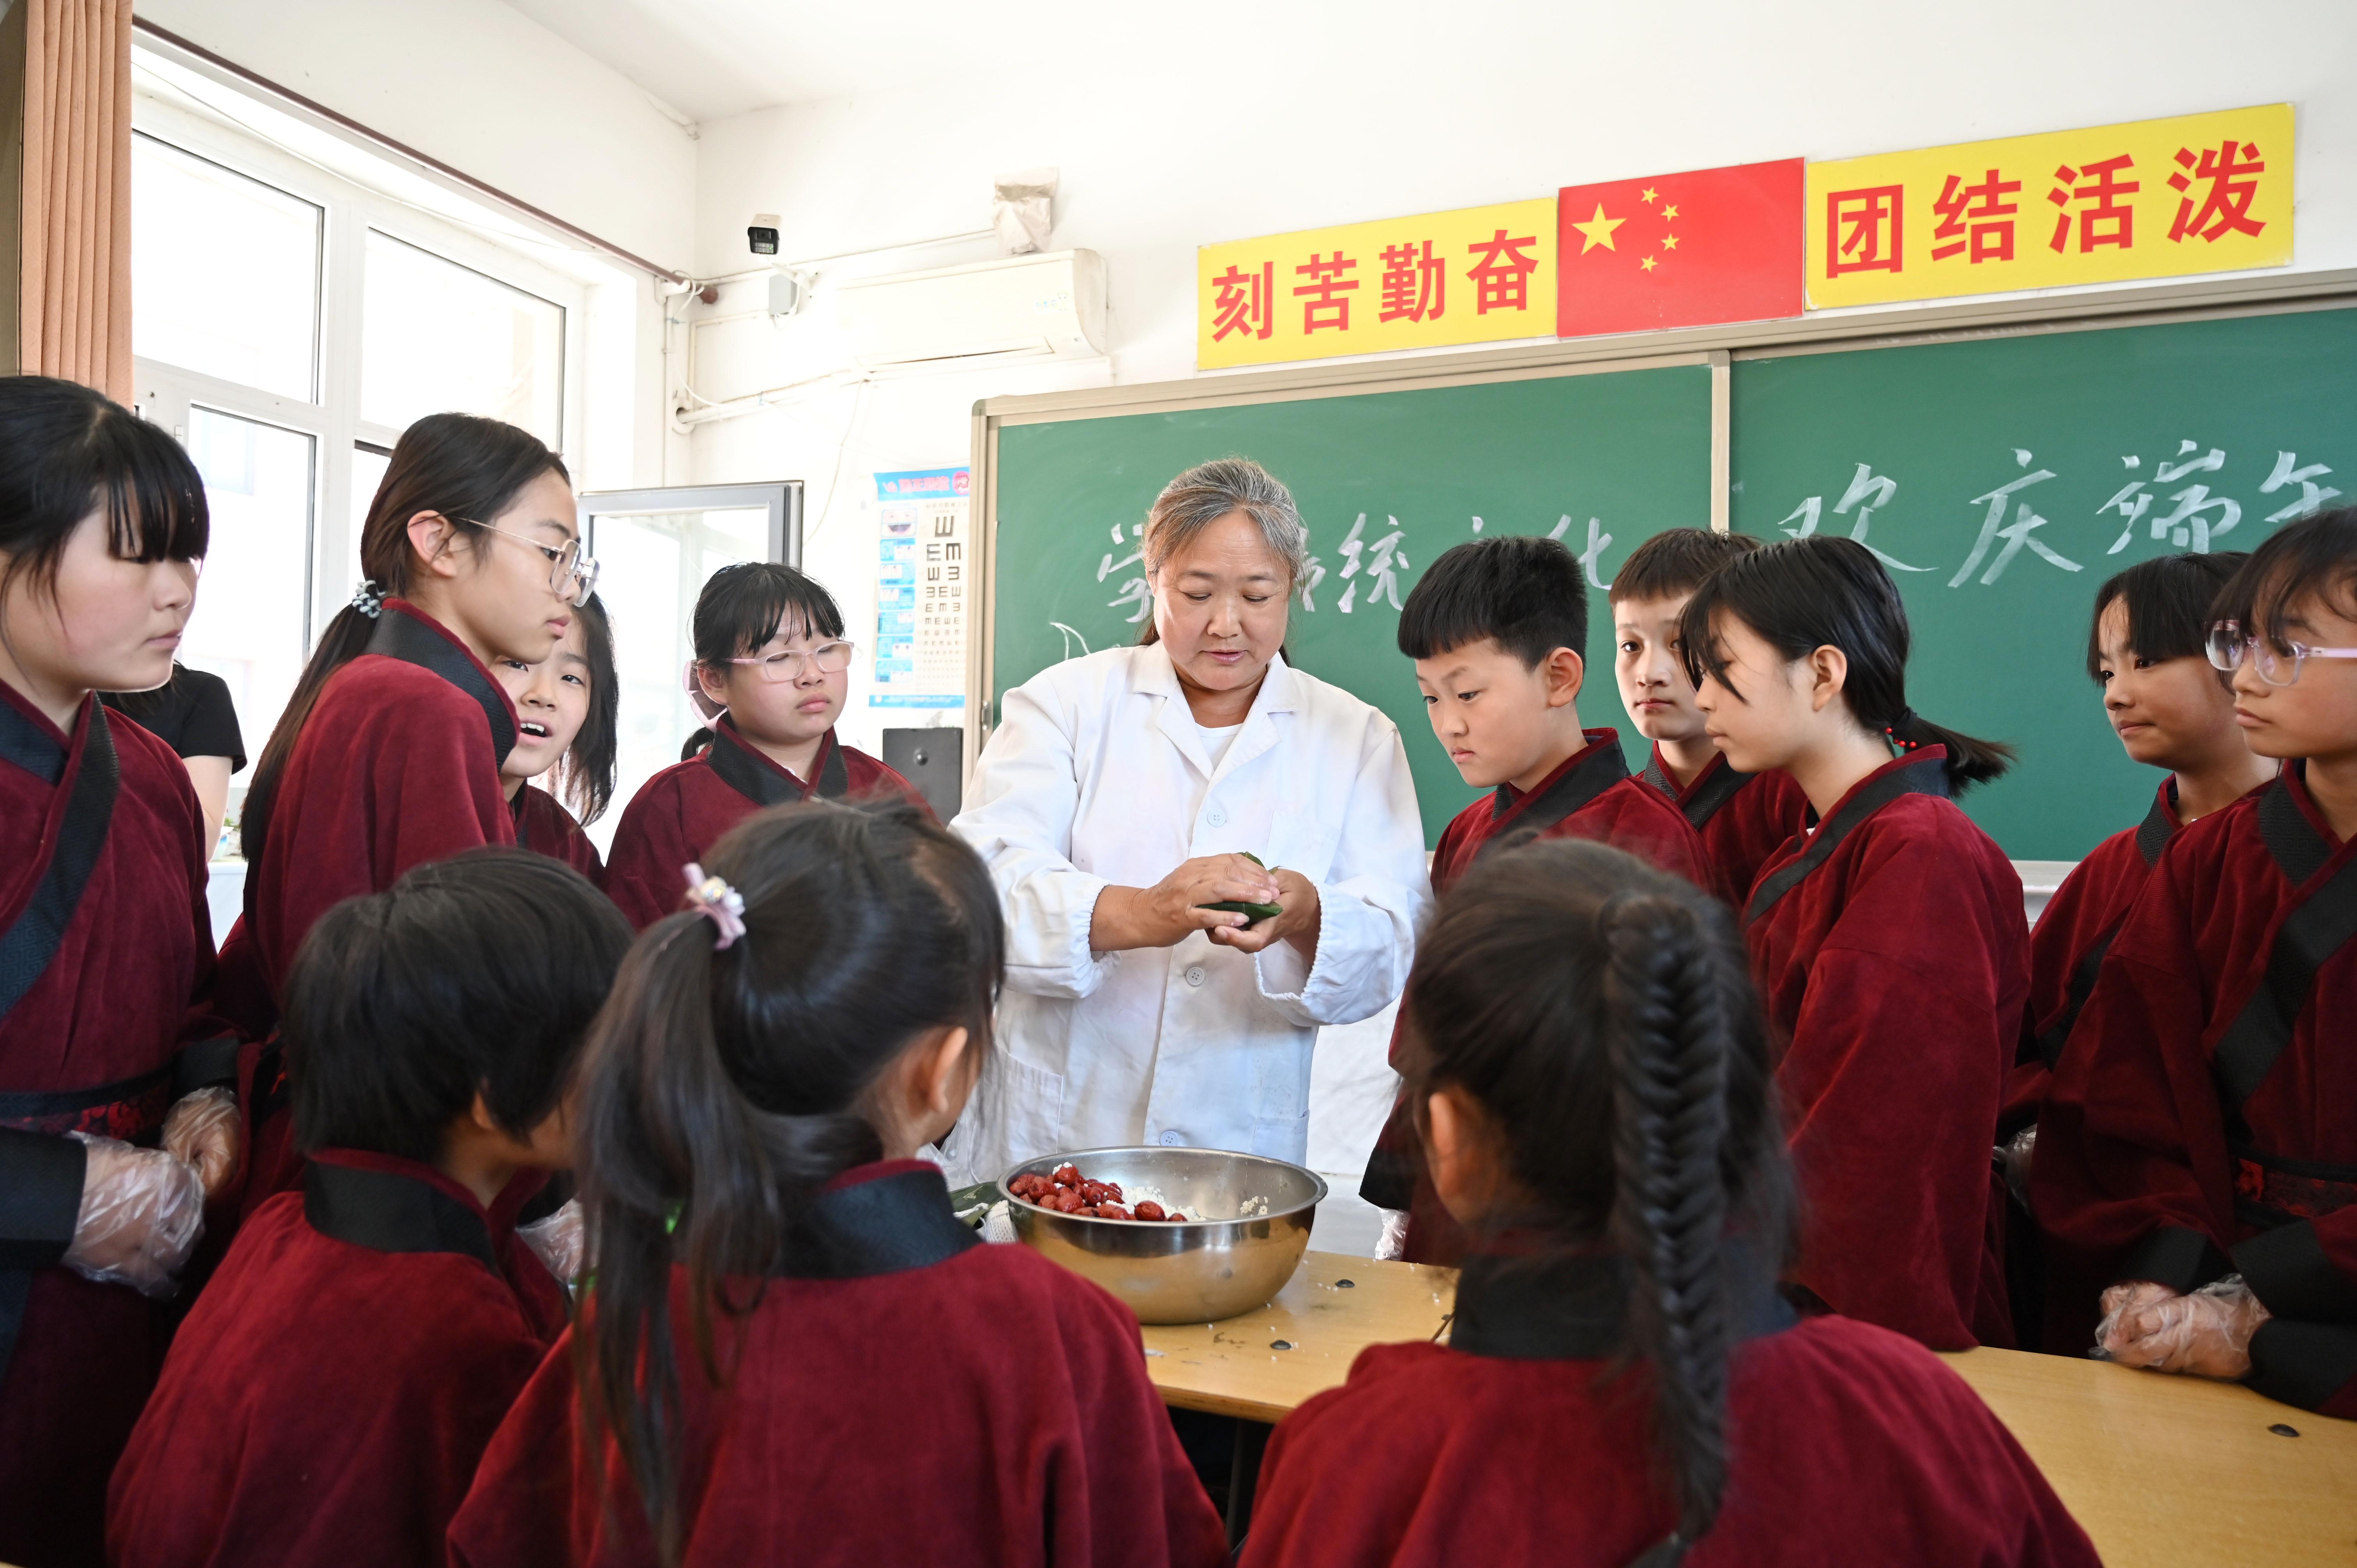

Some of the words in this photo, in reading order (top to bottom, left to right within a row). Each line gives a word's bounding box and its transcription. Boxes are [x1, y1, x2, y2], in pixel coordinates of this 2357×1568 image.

[1827, 140, 2267, 279] 团结活泼
[1211, 230, 1539, 343] 刻苦勤奋
